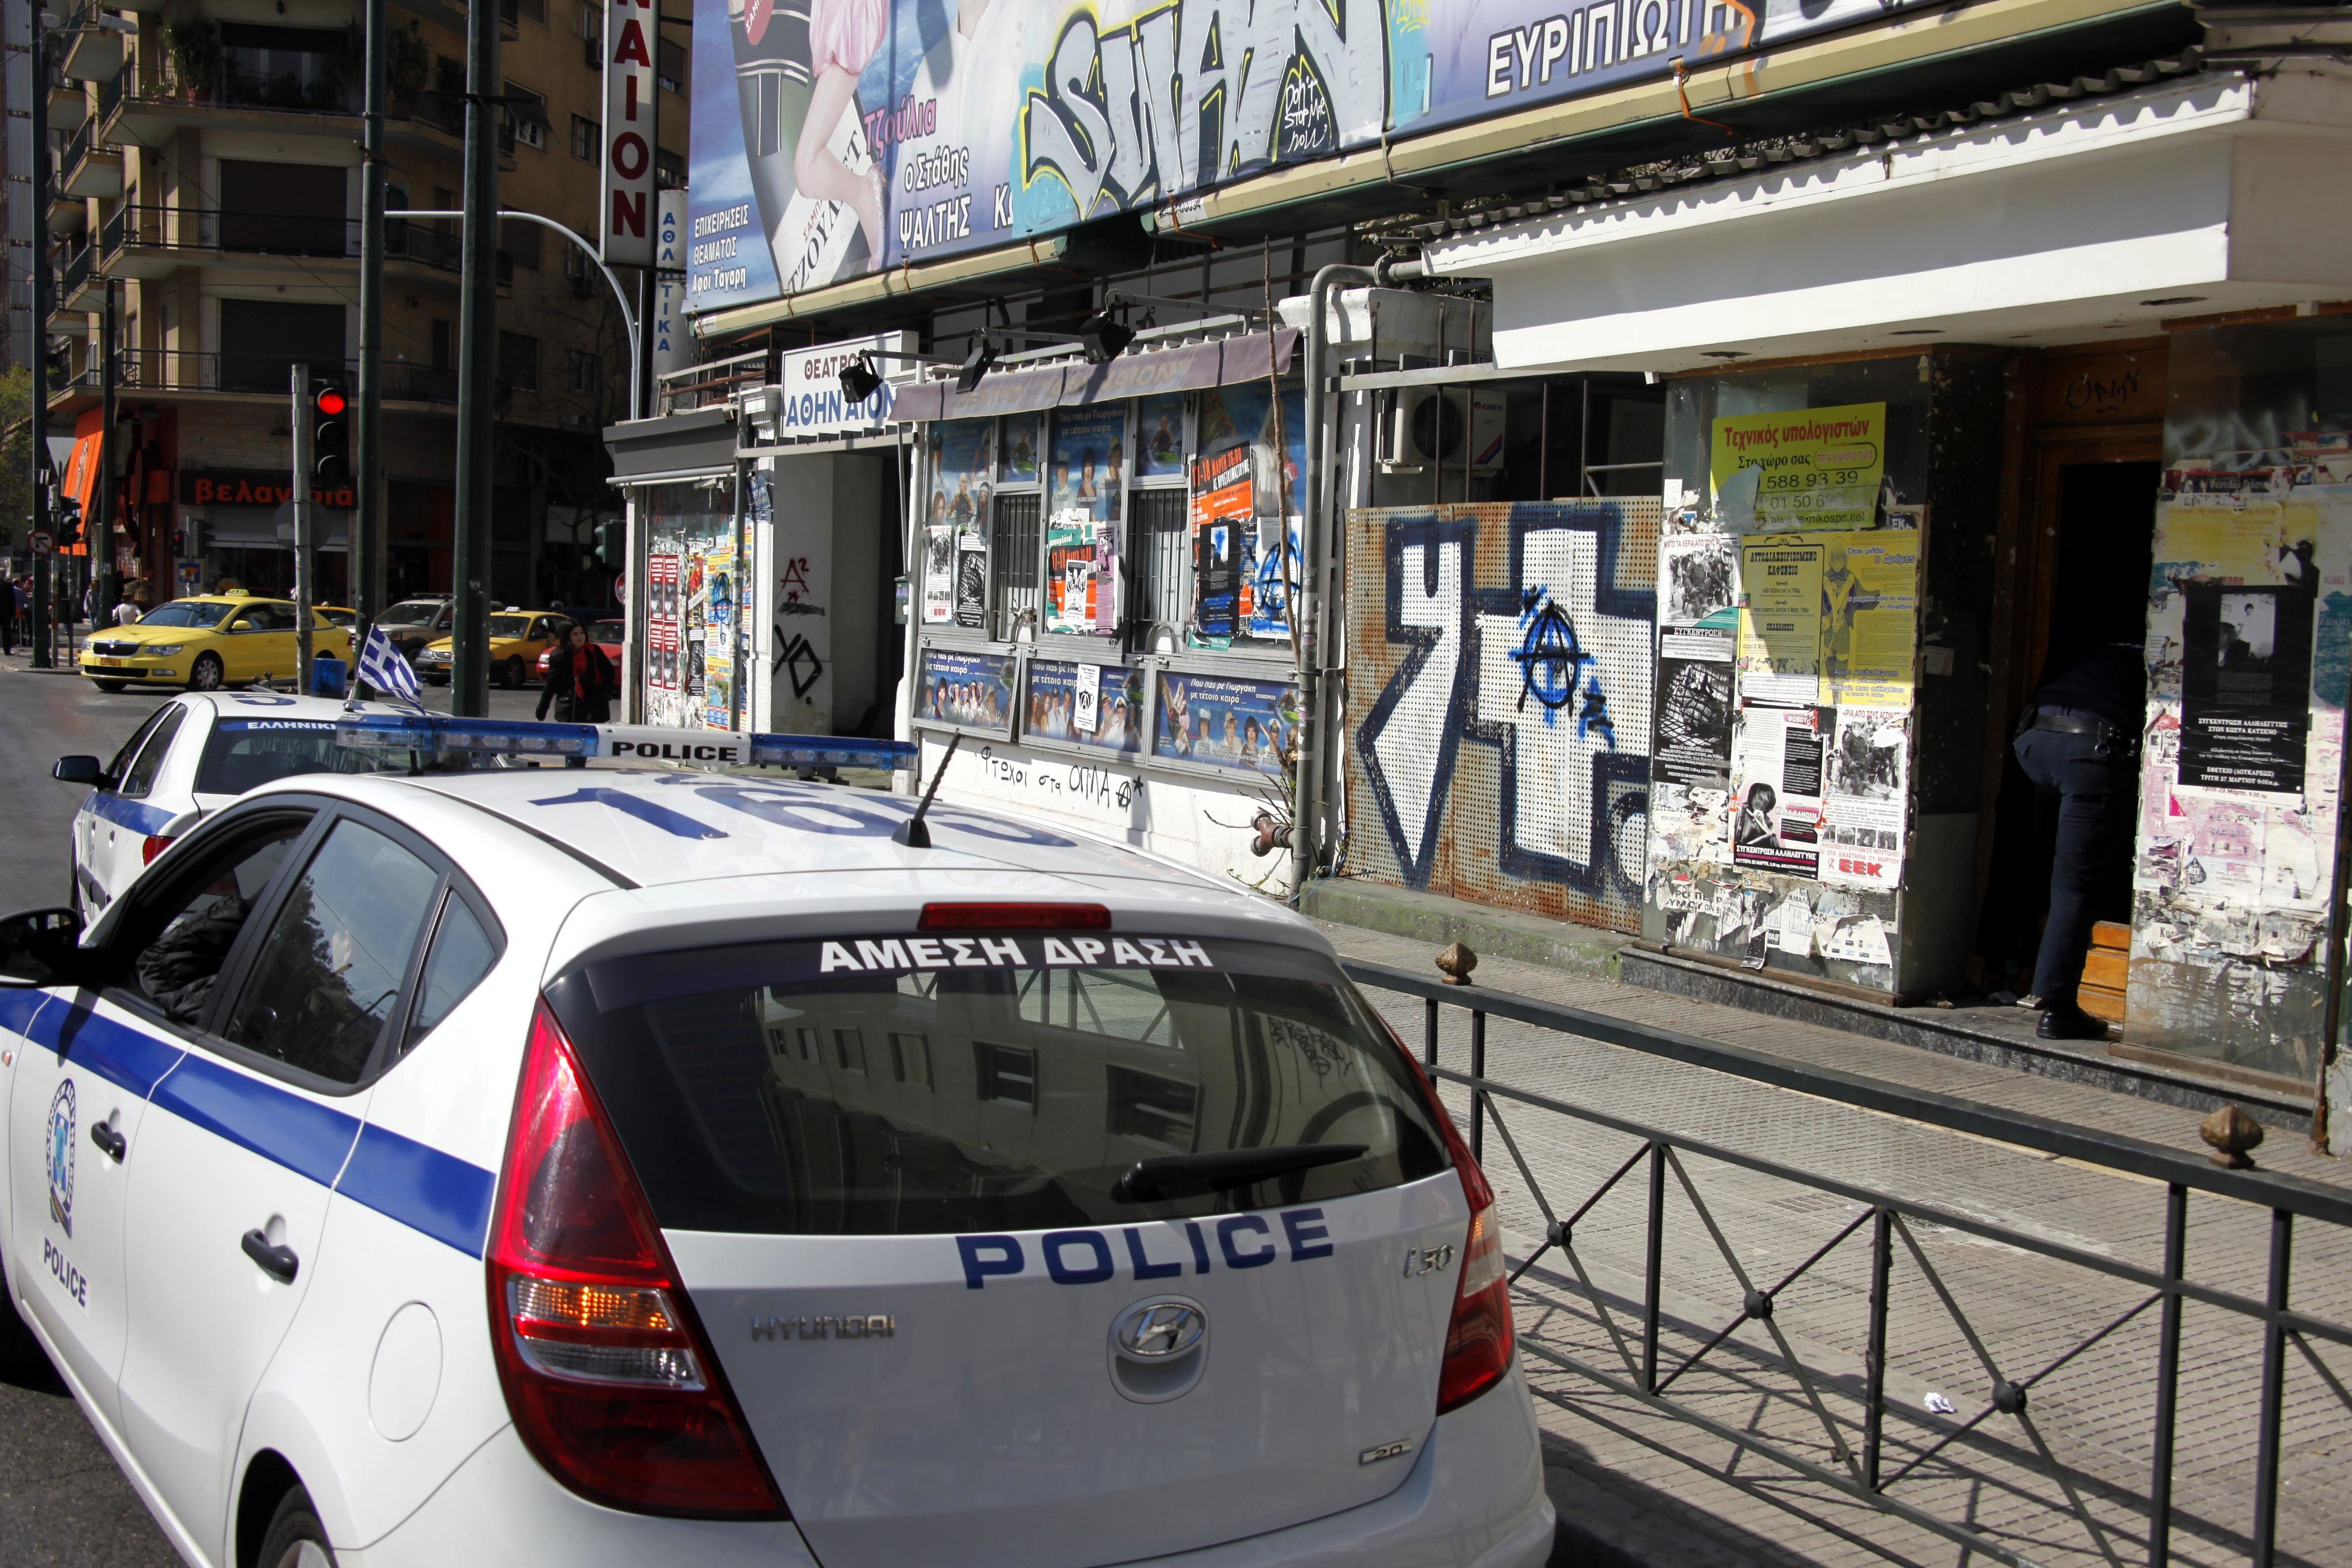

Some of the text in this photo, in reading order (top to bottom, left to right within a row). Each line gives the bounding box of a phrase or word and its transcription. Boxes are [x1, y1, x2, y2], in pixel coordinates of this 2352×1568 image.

[612, 0, 651, 238] ΑΙΟΝ
[864, 94, 936, 160] Τζούλια
[915, 146, 969, 191] Στάθης
[695, 204, 749, 238] ΕΠΙΧΕΙΡΗΣΕΙΣ
[899, 194, 971, 250] ΨΑΛΤΗΣ
[693, 236, 737, 266] ΘΕΑΜΑΤΟΣ
[692, 266, 746, 297] Αφοί Τάγαρη
[1725, 416, 1869, 451] Τεχνικός υπολογιστών
[1761, 453, 1788, 470] χώρο
[1791, 454, 1810, 467] σας
[1767, 470, 1859, 489] 588 93 39
[1767, 565, 1798, 575] ΚΑΦΕΝΕΙΟ
[1673, 627, 1722, 637] ΣΥΓΚΕΝΤΡΩΣΗ
[950, 665, 968, 676] καιρό
[1041, 674, 1061, 685] τέτοιο
[1199, 691, 1219, 701] τέτοιο
[1220, 693, 1240, 705] καιρό
[1226, 681, 1256, 695] Γιωργάκη
[611, 741, 738, 763] POLICE
[2234, 768, 2274, 777] (ΛΟΥΚΑΡΕΩΣ)
[1069, 764, 1110, 808] ΟΠΛΑ
[1794, 808, 1817, 820] ΚΑΝΟΥΝ
[1736, 845, 1816, 860] ΣΥΓΚΕΝΤΡΩΣΗ ΑΛΛΗΛΕΓΓΥΗΣ
[1838, 852, 1866, 861] ΔΙΚΑΣΤΗΡΙΑ
[1877, 857, 1899, 865] ΜΑΡΤΙΟΥ
[1848, 845, 1872, 854] ΚΥΡΙΑΚΟΣ
[1839, 858, 1882, 877] ΕΕΚ
[820, 937, 1215, 973] ΑΜΕΣΗ ΔΡΑΣΗ
[955, 1207, 1334, 1290] POLICE
[44, 1237, 86, 1307] POLICE
[751, 1314, 896, 1341] HYUNDAI
